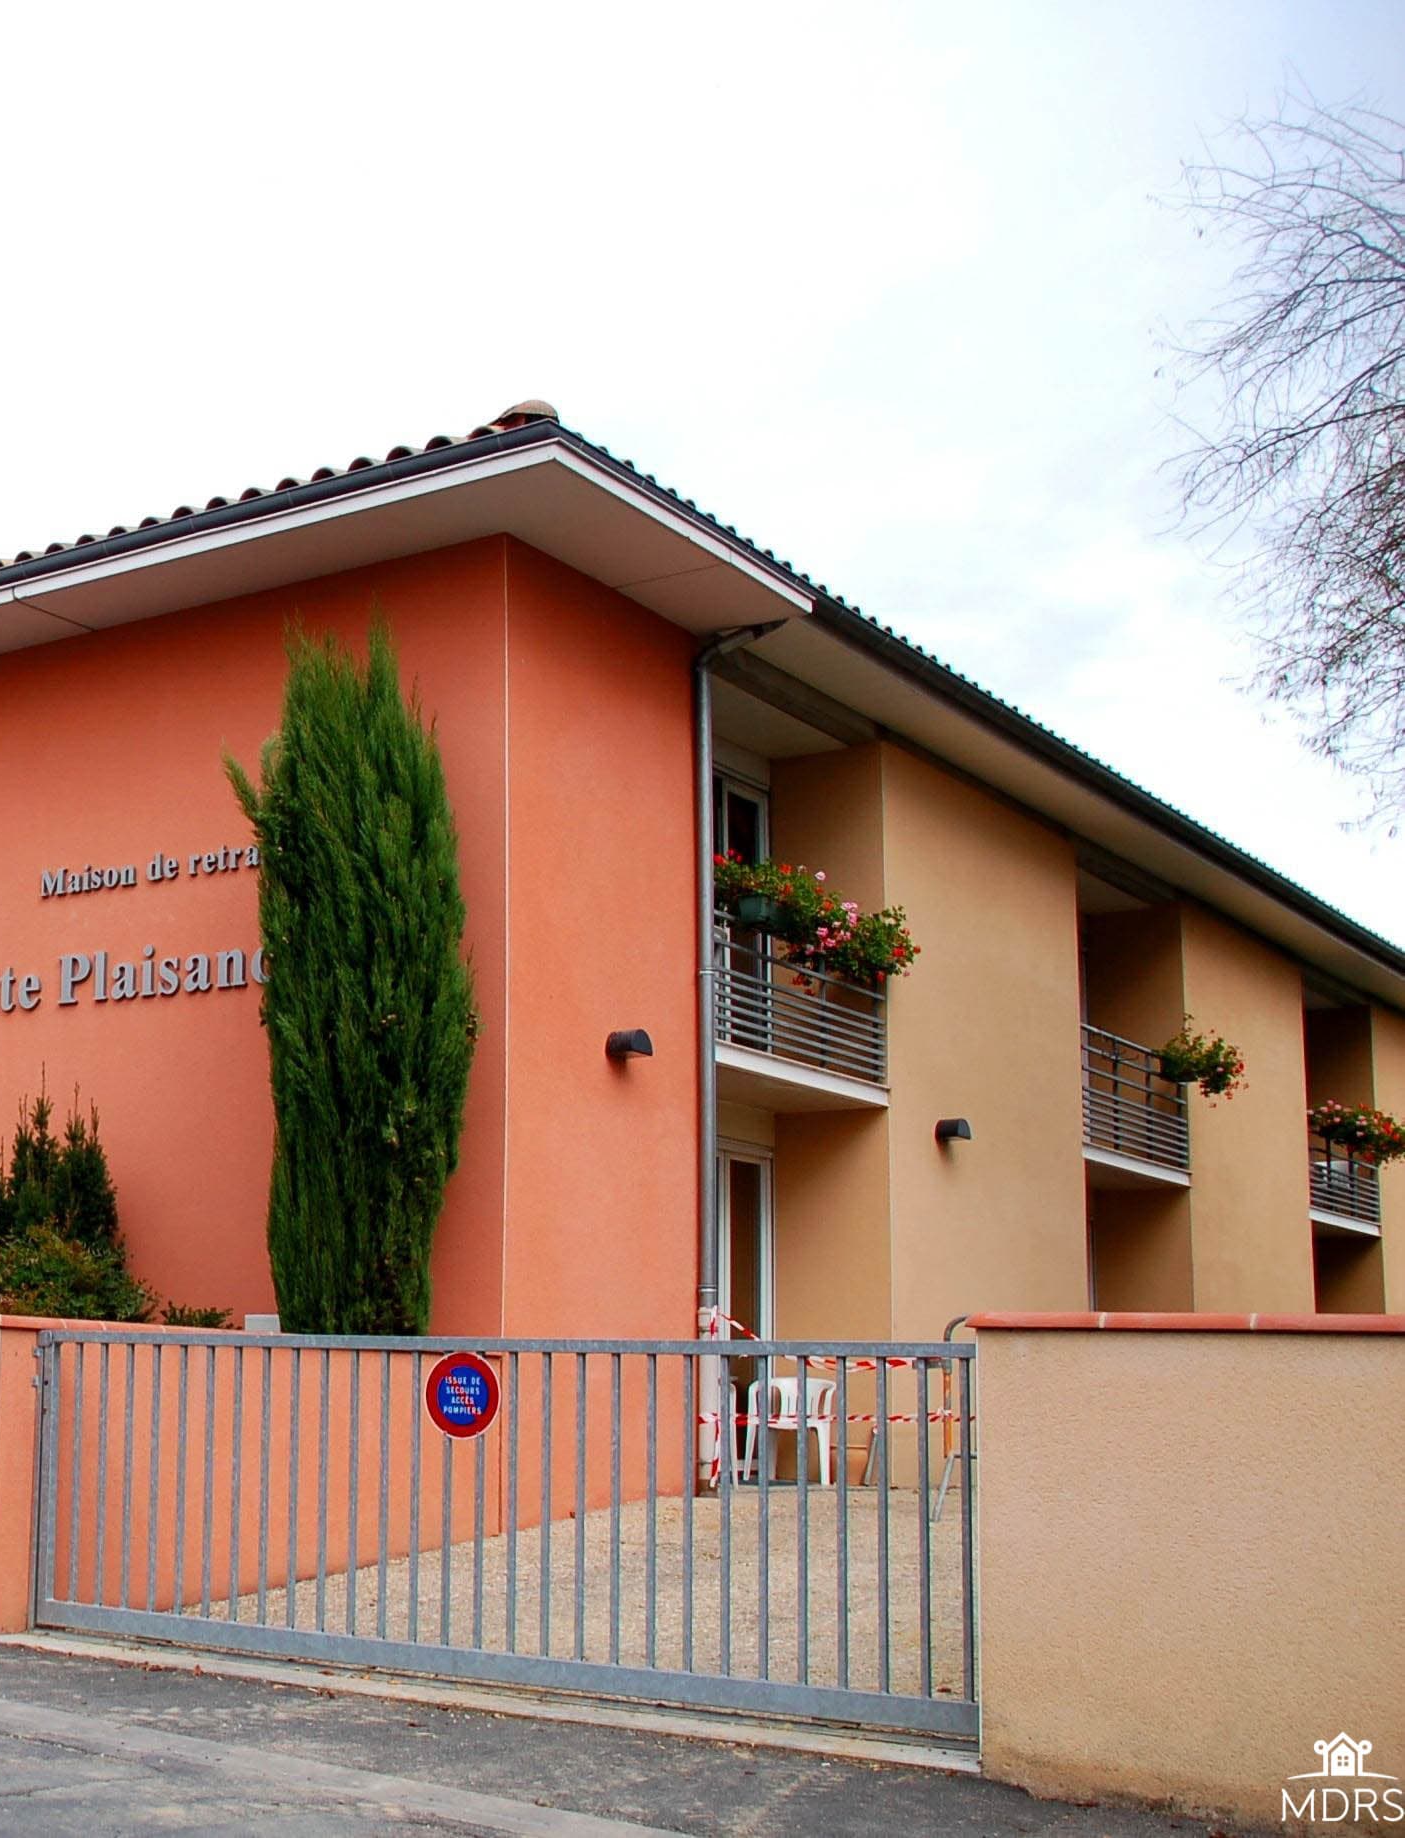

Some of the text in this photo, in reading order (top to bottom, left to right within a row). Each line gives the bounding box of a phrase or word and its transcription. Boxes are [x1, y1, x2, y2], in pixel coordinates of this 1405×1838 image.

[40, 865, 136, 898] Maison
[146, 851, 179, 881] de
[445, 1376, 481, 1386] ISSUE DE
[446, 1386, 480, 1395] SECOURS
[443, 1406, 482, 1415] POMPIERS
